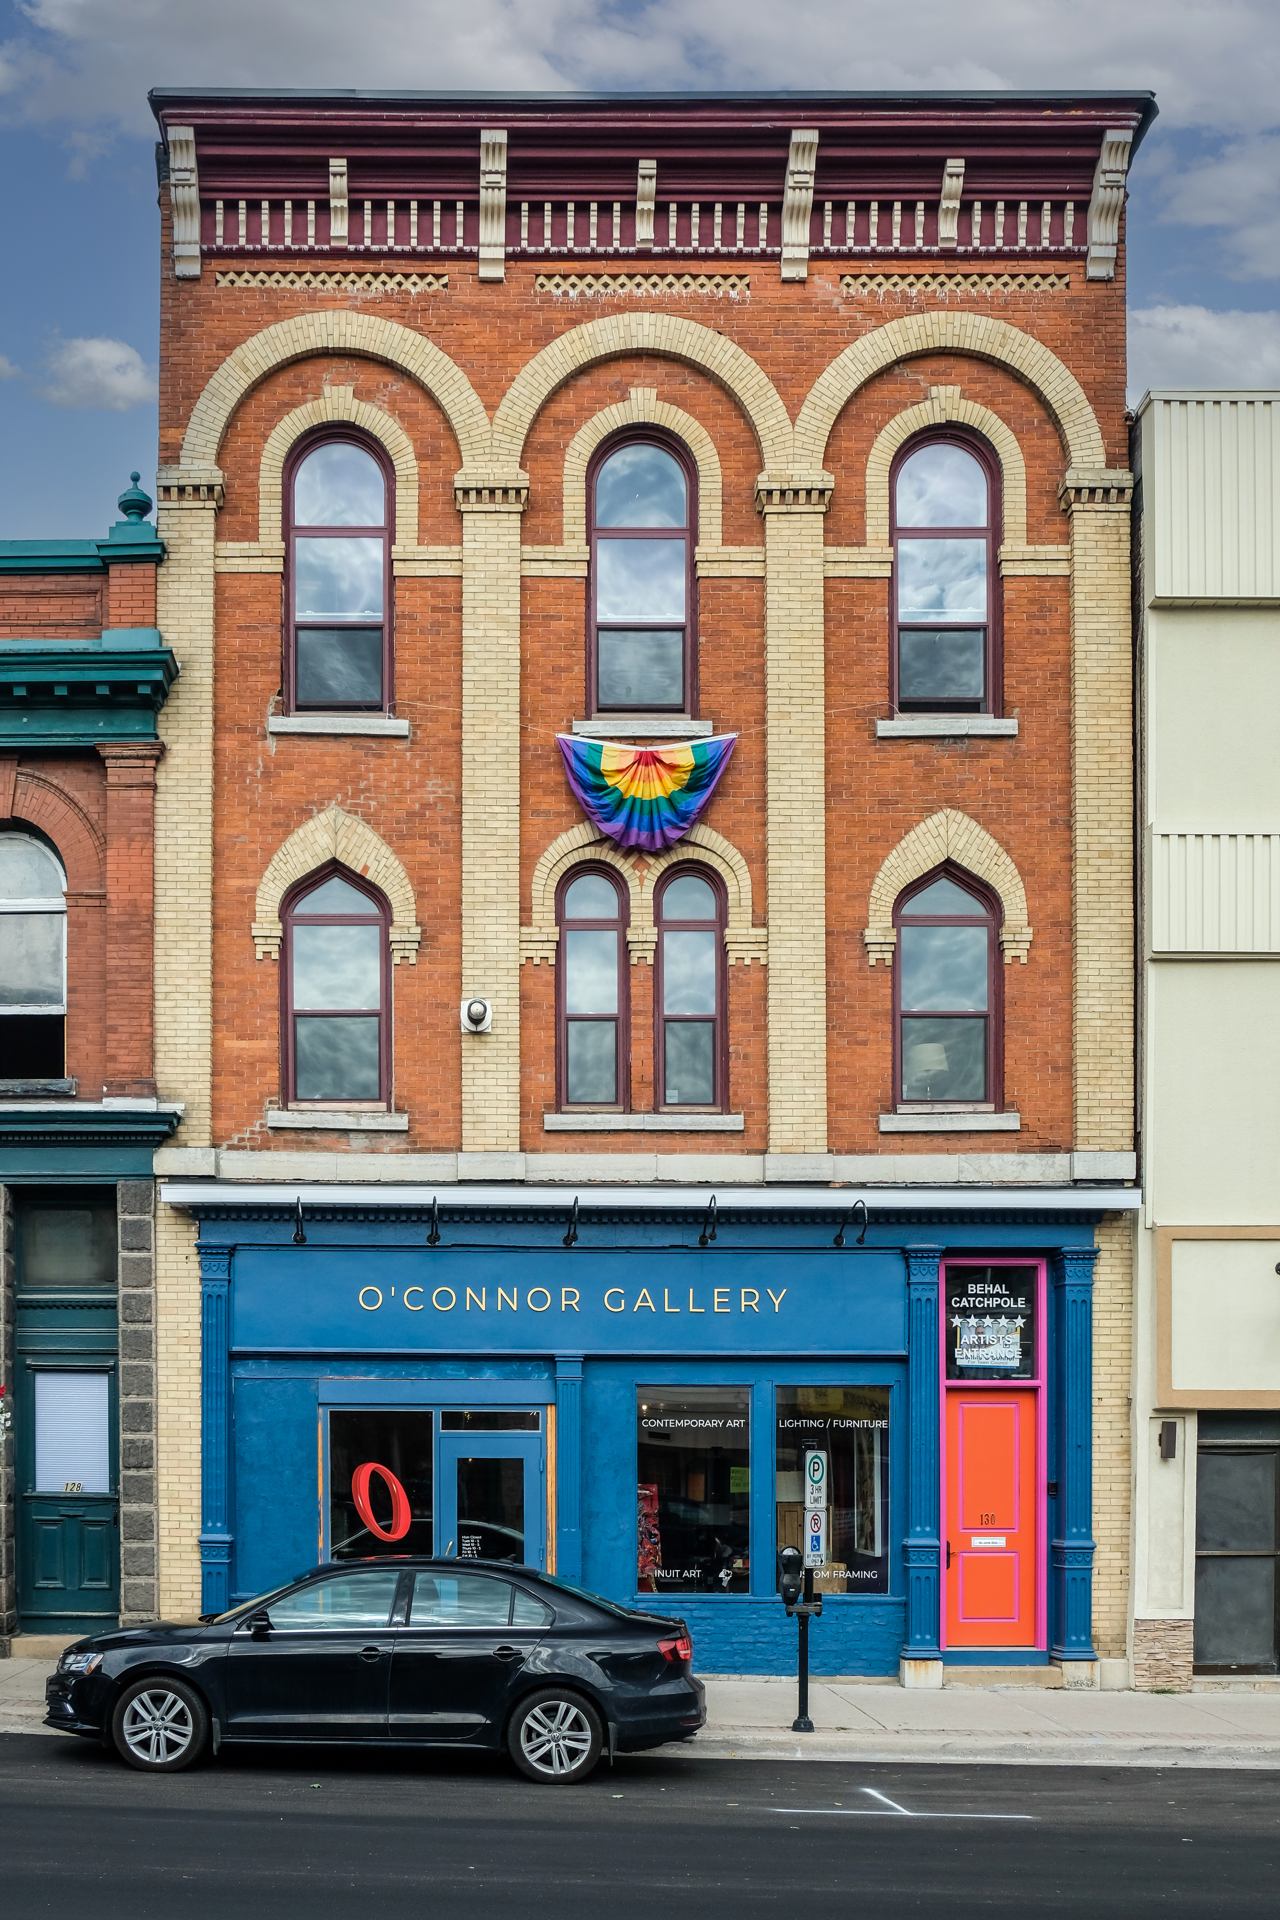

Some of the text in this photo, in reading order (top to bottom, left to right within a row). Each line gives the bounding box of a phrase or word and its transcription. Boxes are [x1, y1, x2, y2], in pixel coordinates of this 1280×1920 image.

[967, 1283, 1010, 1294] BEHAL
[358, 1286, 788, 1313] O'CONNOR GALLERY
[951, 1297, 1026, 1308] CATCHPOLE
[960, 1334, 1013, 1345] ARTISTS
[954, 1348, 1023, 1359] ENTRANCE
[641, 1419, 746, 1428] CONTEMPORARY ART
[778, 1419, 824, 1428] LIGHTING
[832, 1419, 889, 1429] FURNITURE
[64, 1482, 82, 1492] 128
[810, 1484, 822, 1495] 3 HR
[810, 1495, 822, 1505] LIMIT
[980, 1513, 996, 1526] 130
[654, 1569, 702, 1578] INUIT ART
[833, 1570, 878, 1579] FRAMING
